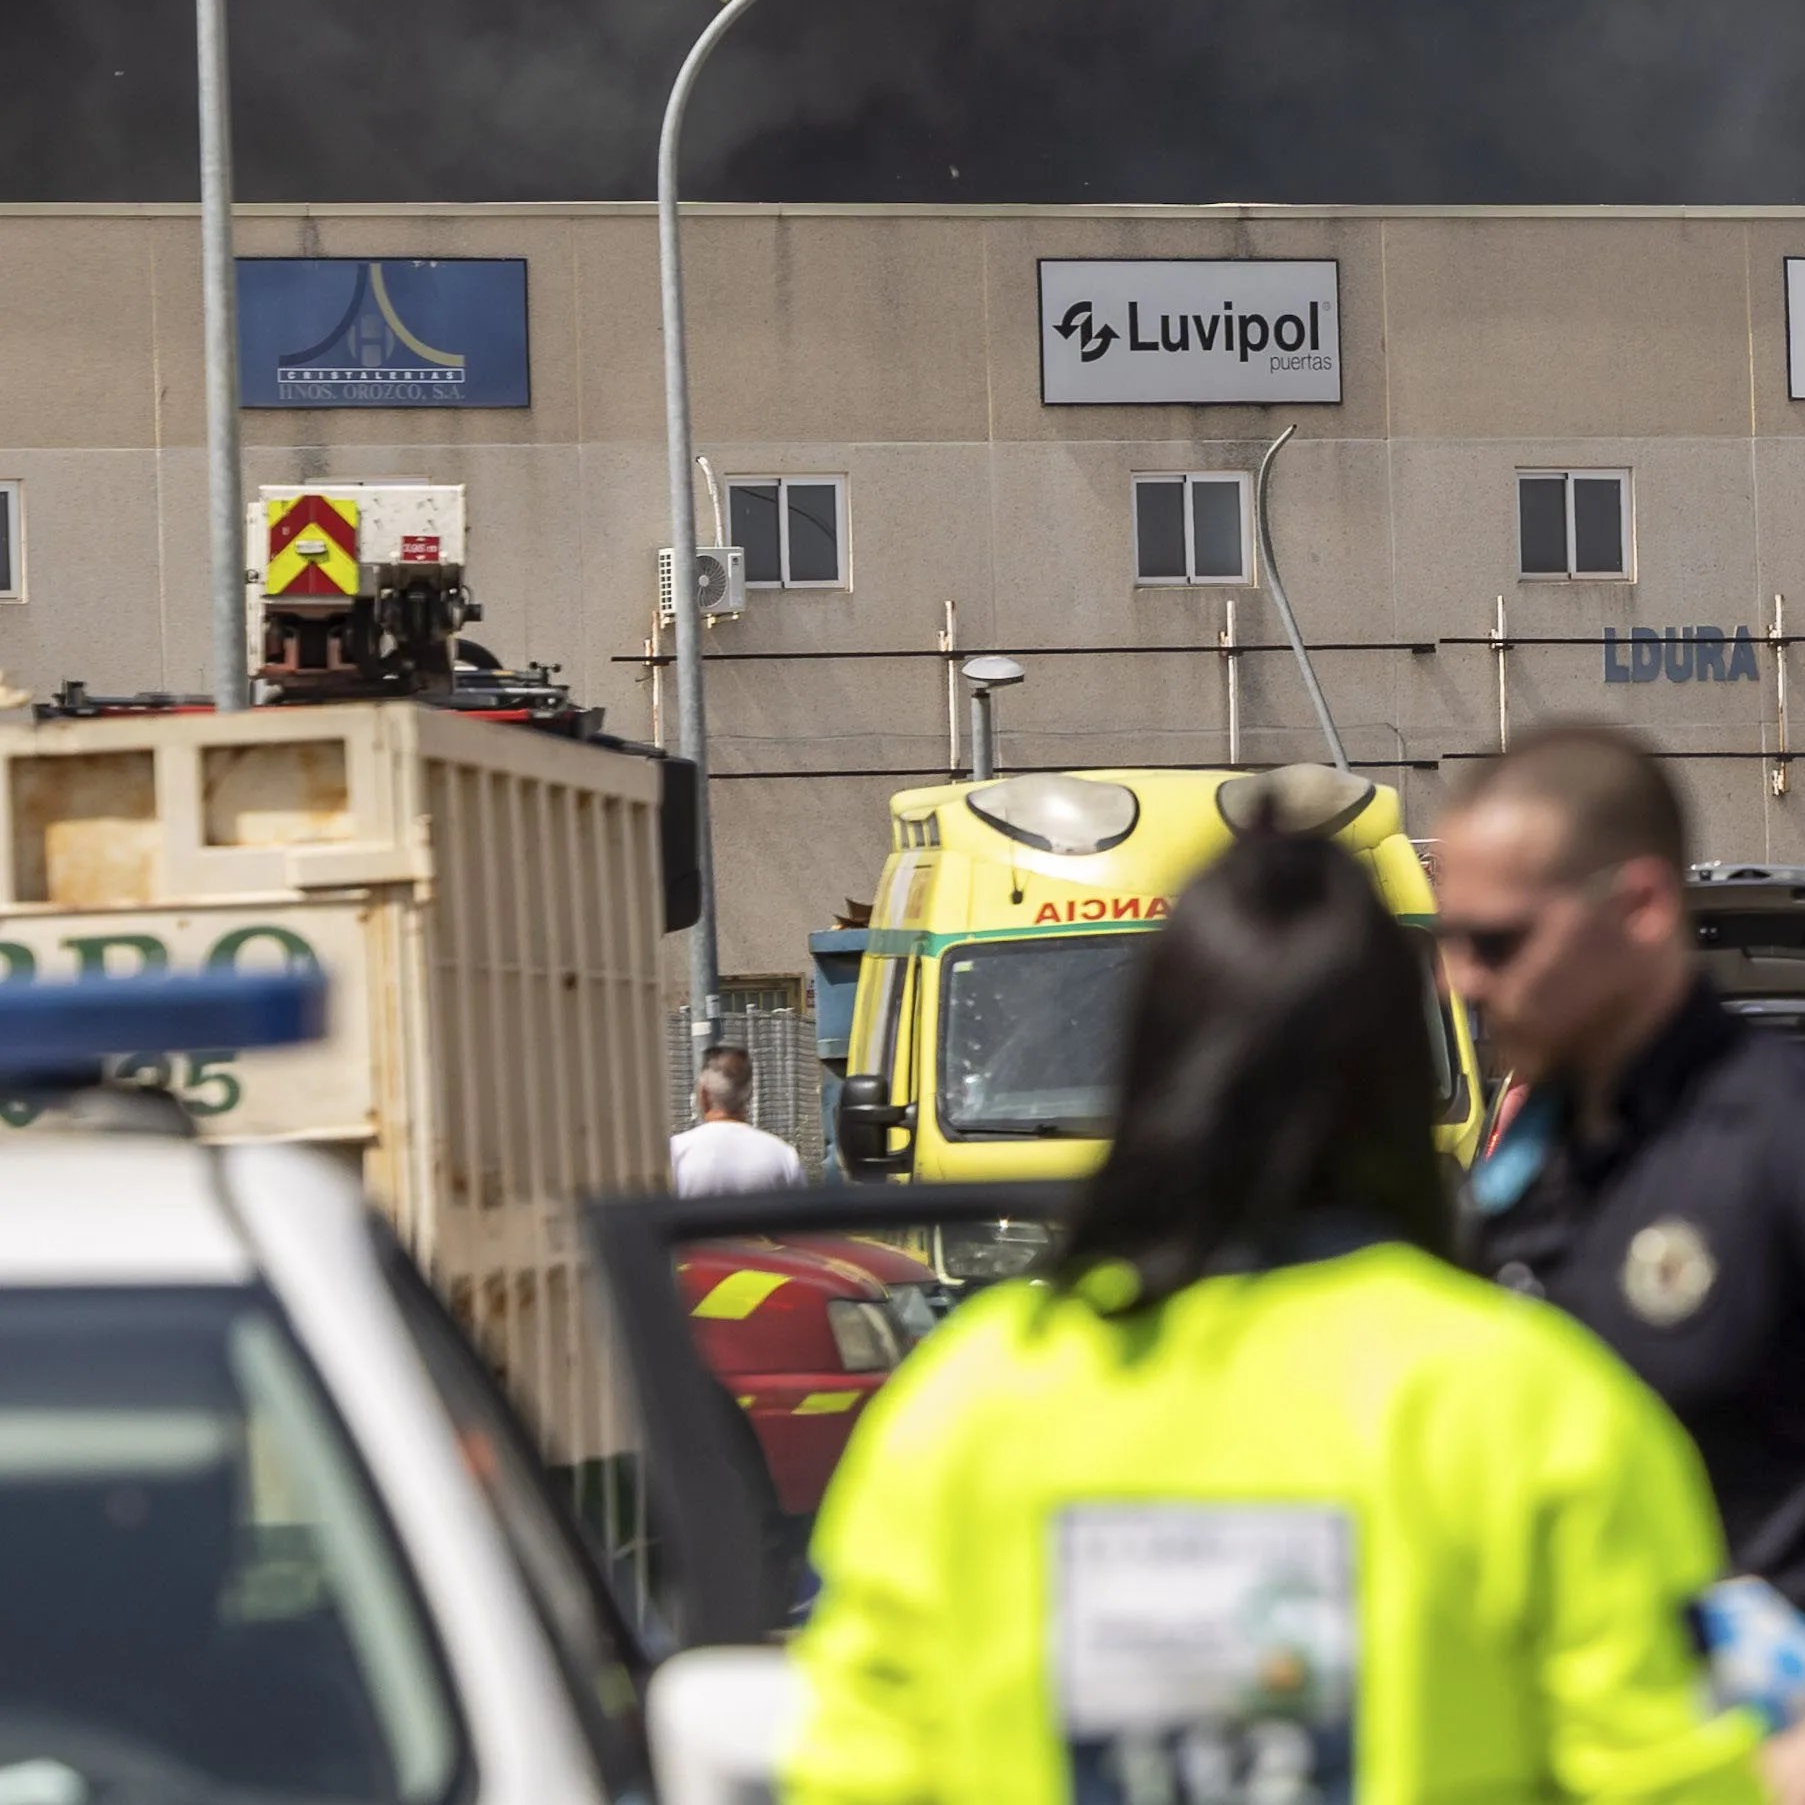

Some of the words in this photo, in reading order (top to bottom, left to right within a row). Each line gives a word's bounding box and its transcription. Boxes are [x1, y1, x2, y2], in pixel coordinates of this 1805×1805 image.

[1127, 300, 1320, 363] Luvipol
[1270, 352, 1333, 375] puertas
[286, 370, 455, 381] CRISTALERIAS
